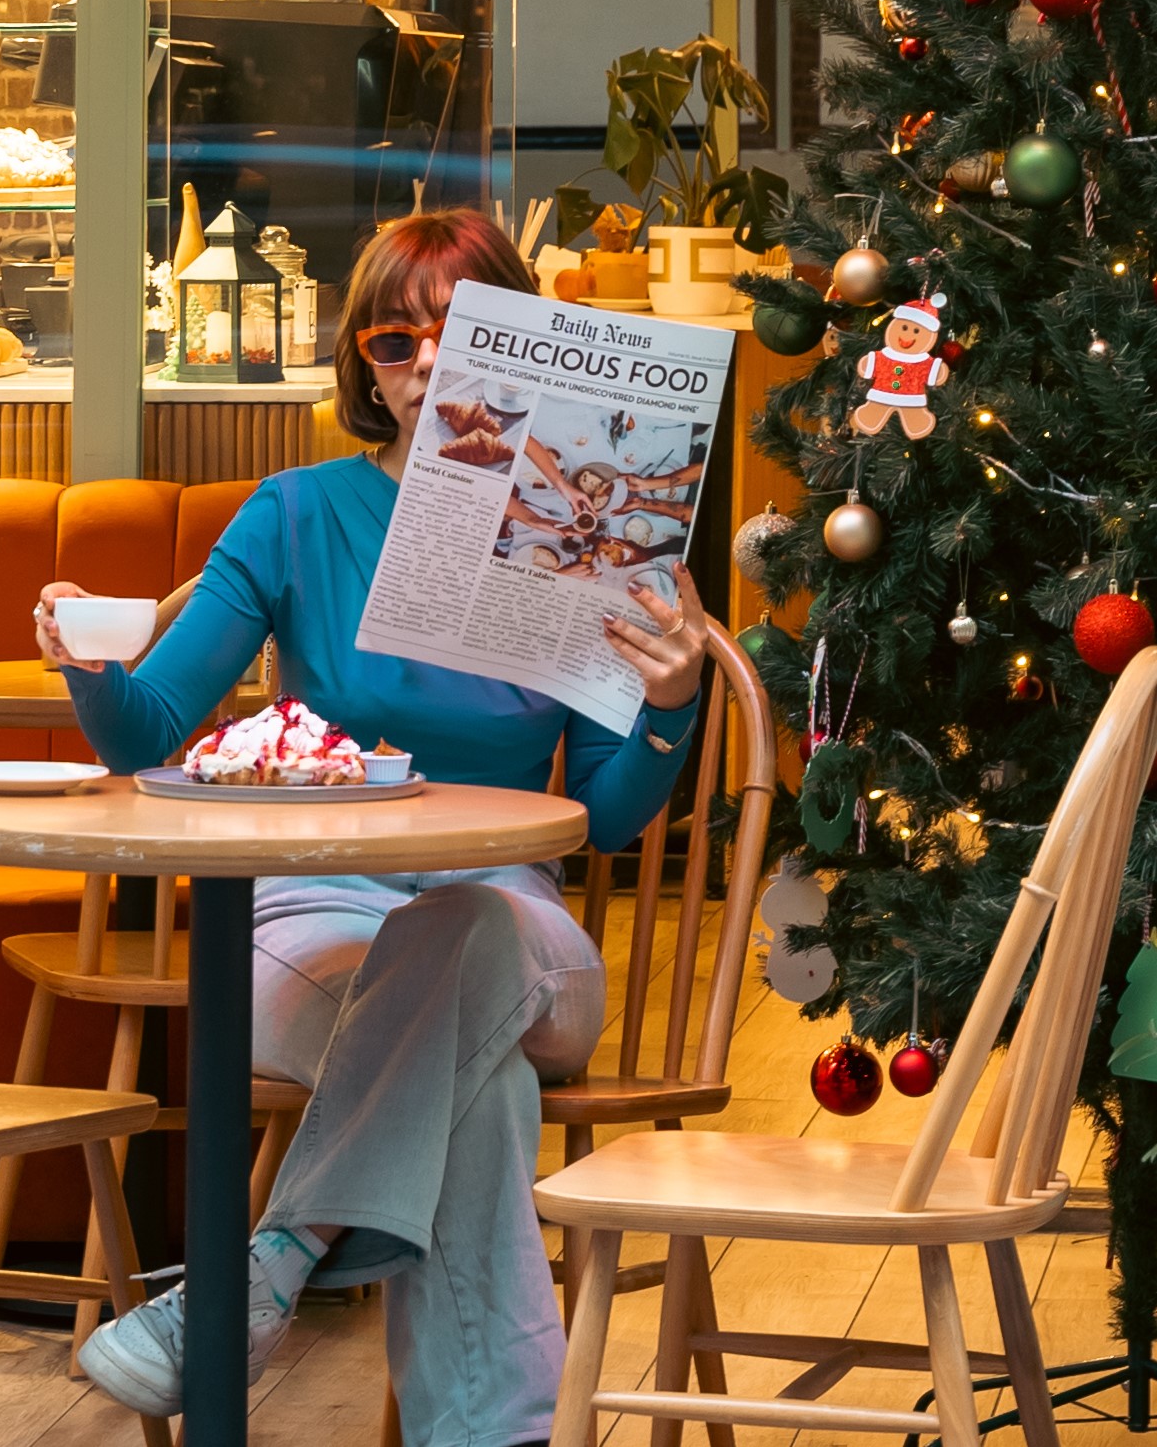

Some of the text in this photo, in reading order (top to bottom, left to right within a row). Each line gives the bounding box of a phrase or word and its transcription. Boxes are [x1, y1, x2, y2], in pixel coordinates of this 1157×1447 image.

[551, 312, 652, 349] Daily News
[470, 326, 708, 394] DELICIOUS FOOD
[508, 369, 542, 384] CUISINE
[544, 377, 552, 385] IS
[553, 379, 567, 389] AN
[568, 381, 635, 404] UNDISCOVERED
[636, 397, 676, 411] DIAMOND
[412, 462, 474, 484] World Cuisine
[489, 559, 556, 581] Colorful Tables
